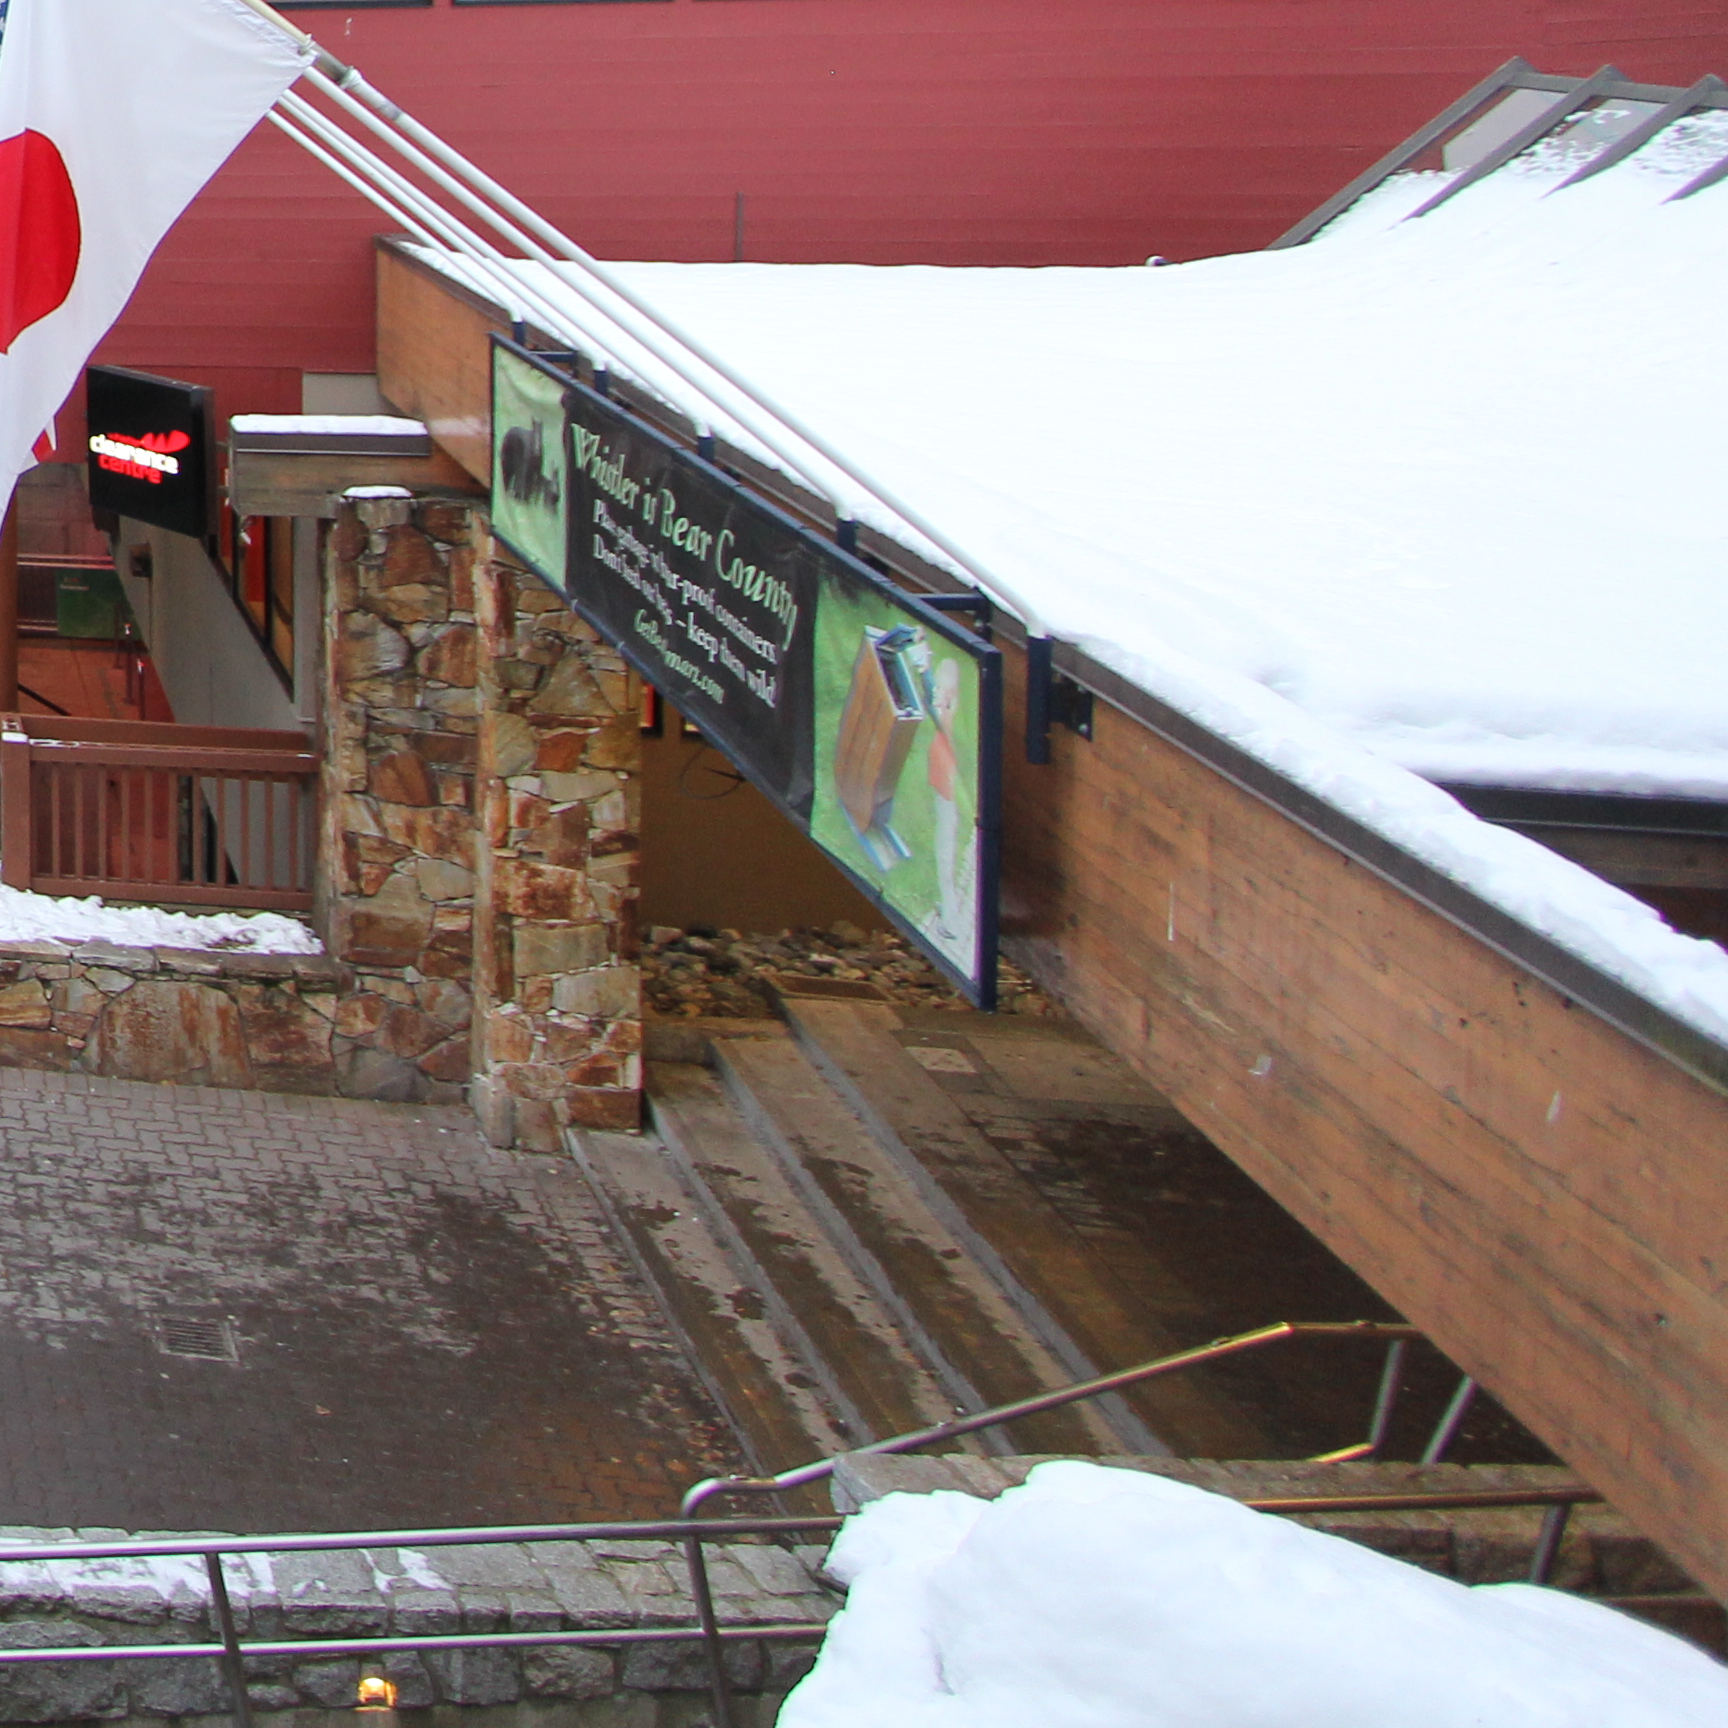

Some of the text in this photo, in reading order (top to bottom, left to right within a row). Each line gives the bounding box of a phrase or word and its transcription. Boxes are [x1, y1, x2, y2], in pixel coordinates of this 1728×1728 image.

[89, 433, 179, 475] clearance
[98, 454, 163, 485] centre
[571, 423, 640, 510] Whistler
[642, 477, 658, 526] is
[659, 488, 713, 562] Bear
[687, 611, 719, 663] keep
[746, 668, 776, 708] wild
